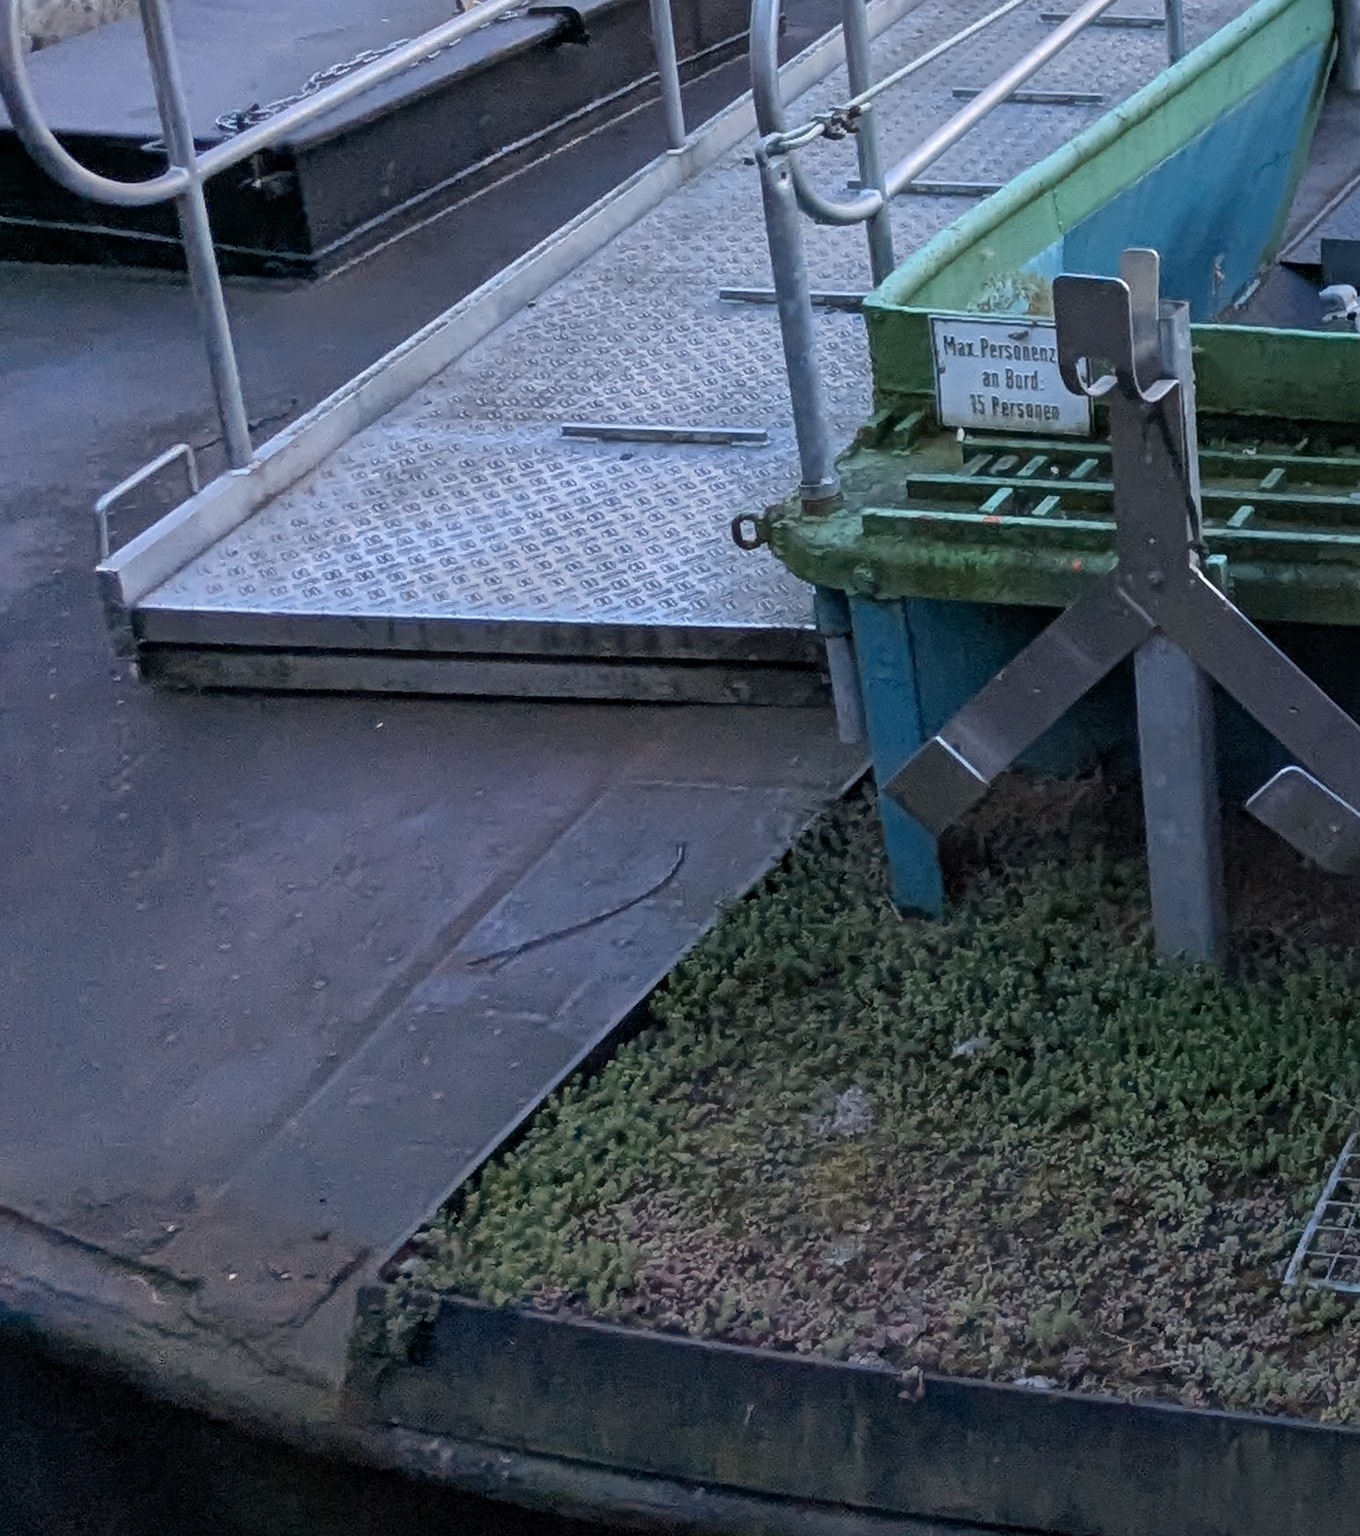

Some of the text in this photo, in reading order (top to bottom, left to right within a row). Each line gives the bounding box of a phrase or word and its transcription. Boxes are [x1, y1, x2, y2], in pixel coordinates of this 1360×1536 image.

[943, 336, 1057, 364] Max. Personenz
[982, 370, 999, 388] an
[969, 394, 1060, 421] 15 Personen
